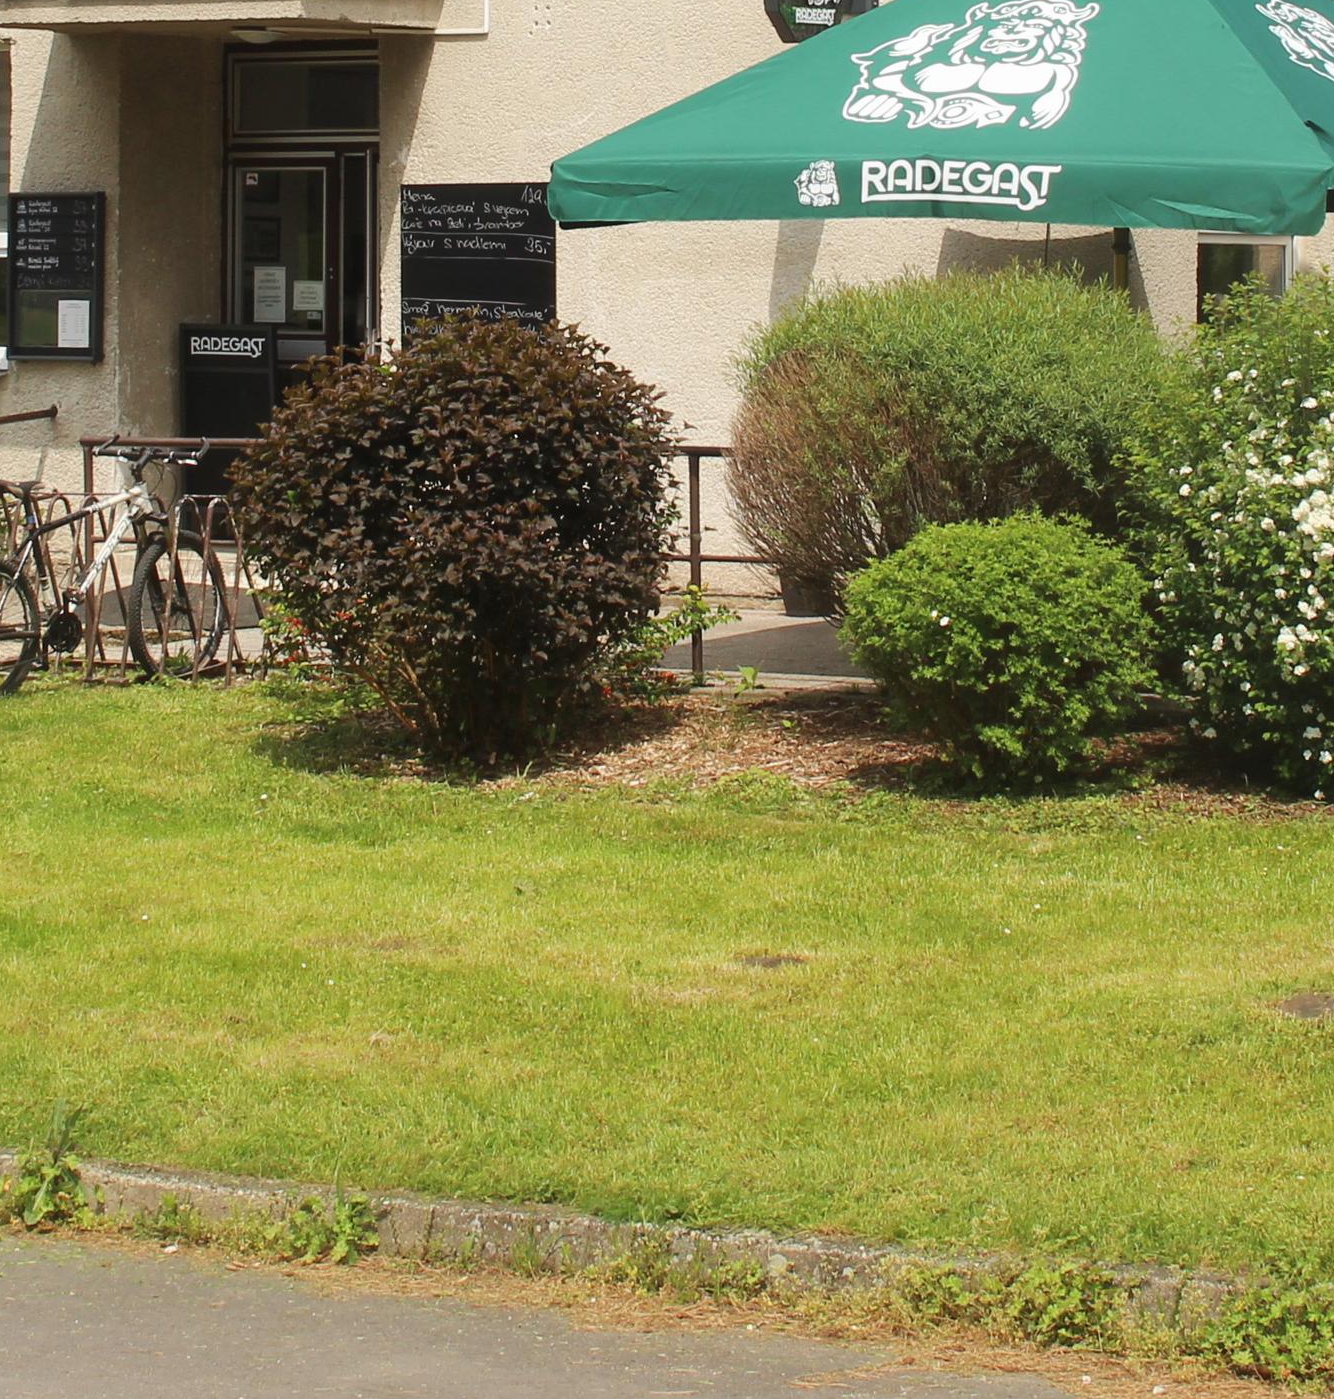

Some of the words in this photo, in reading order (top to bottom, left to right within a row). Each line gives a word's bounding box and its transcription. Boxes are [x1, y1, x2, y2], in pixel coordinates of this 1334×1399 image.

[792, 6, 837, 26] RADEGAST
[861, 159, 1062, 212] RADEGAST
[190, 336, 266, 358] RADEGAST
